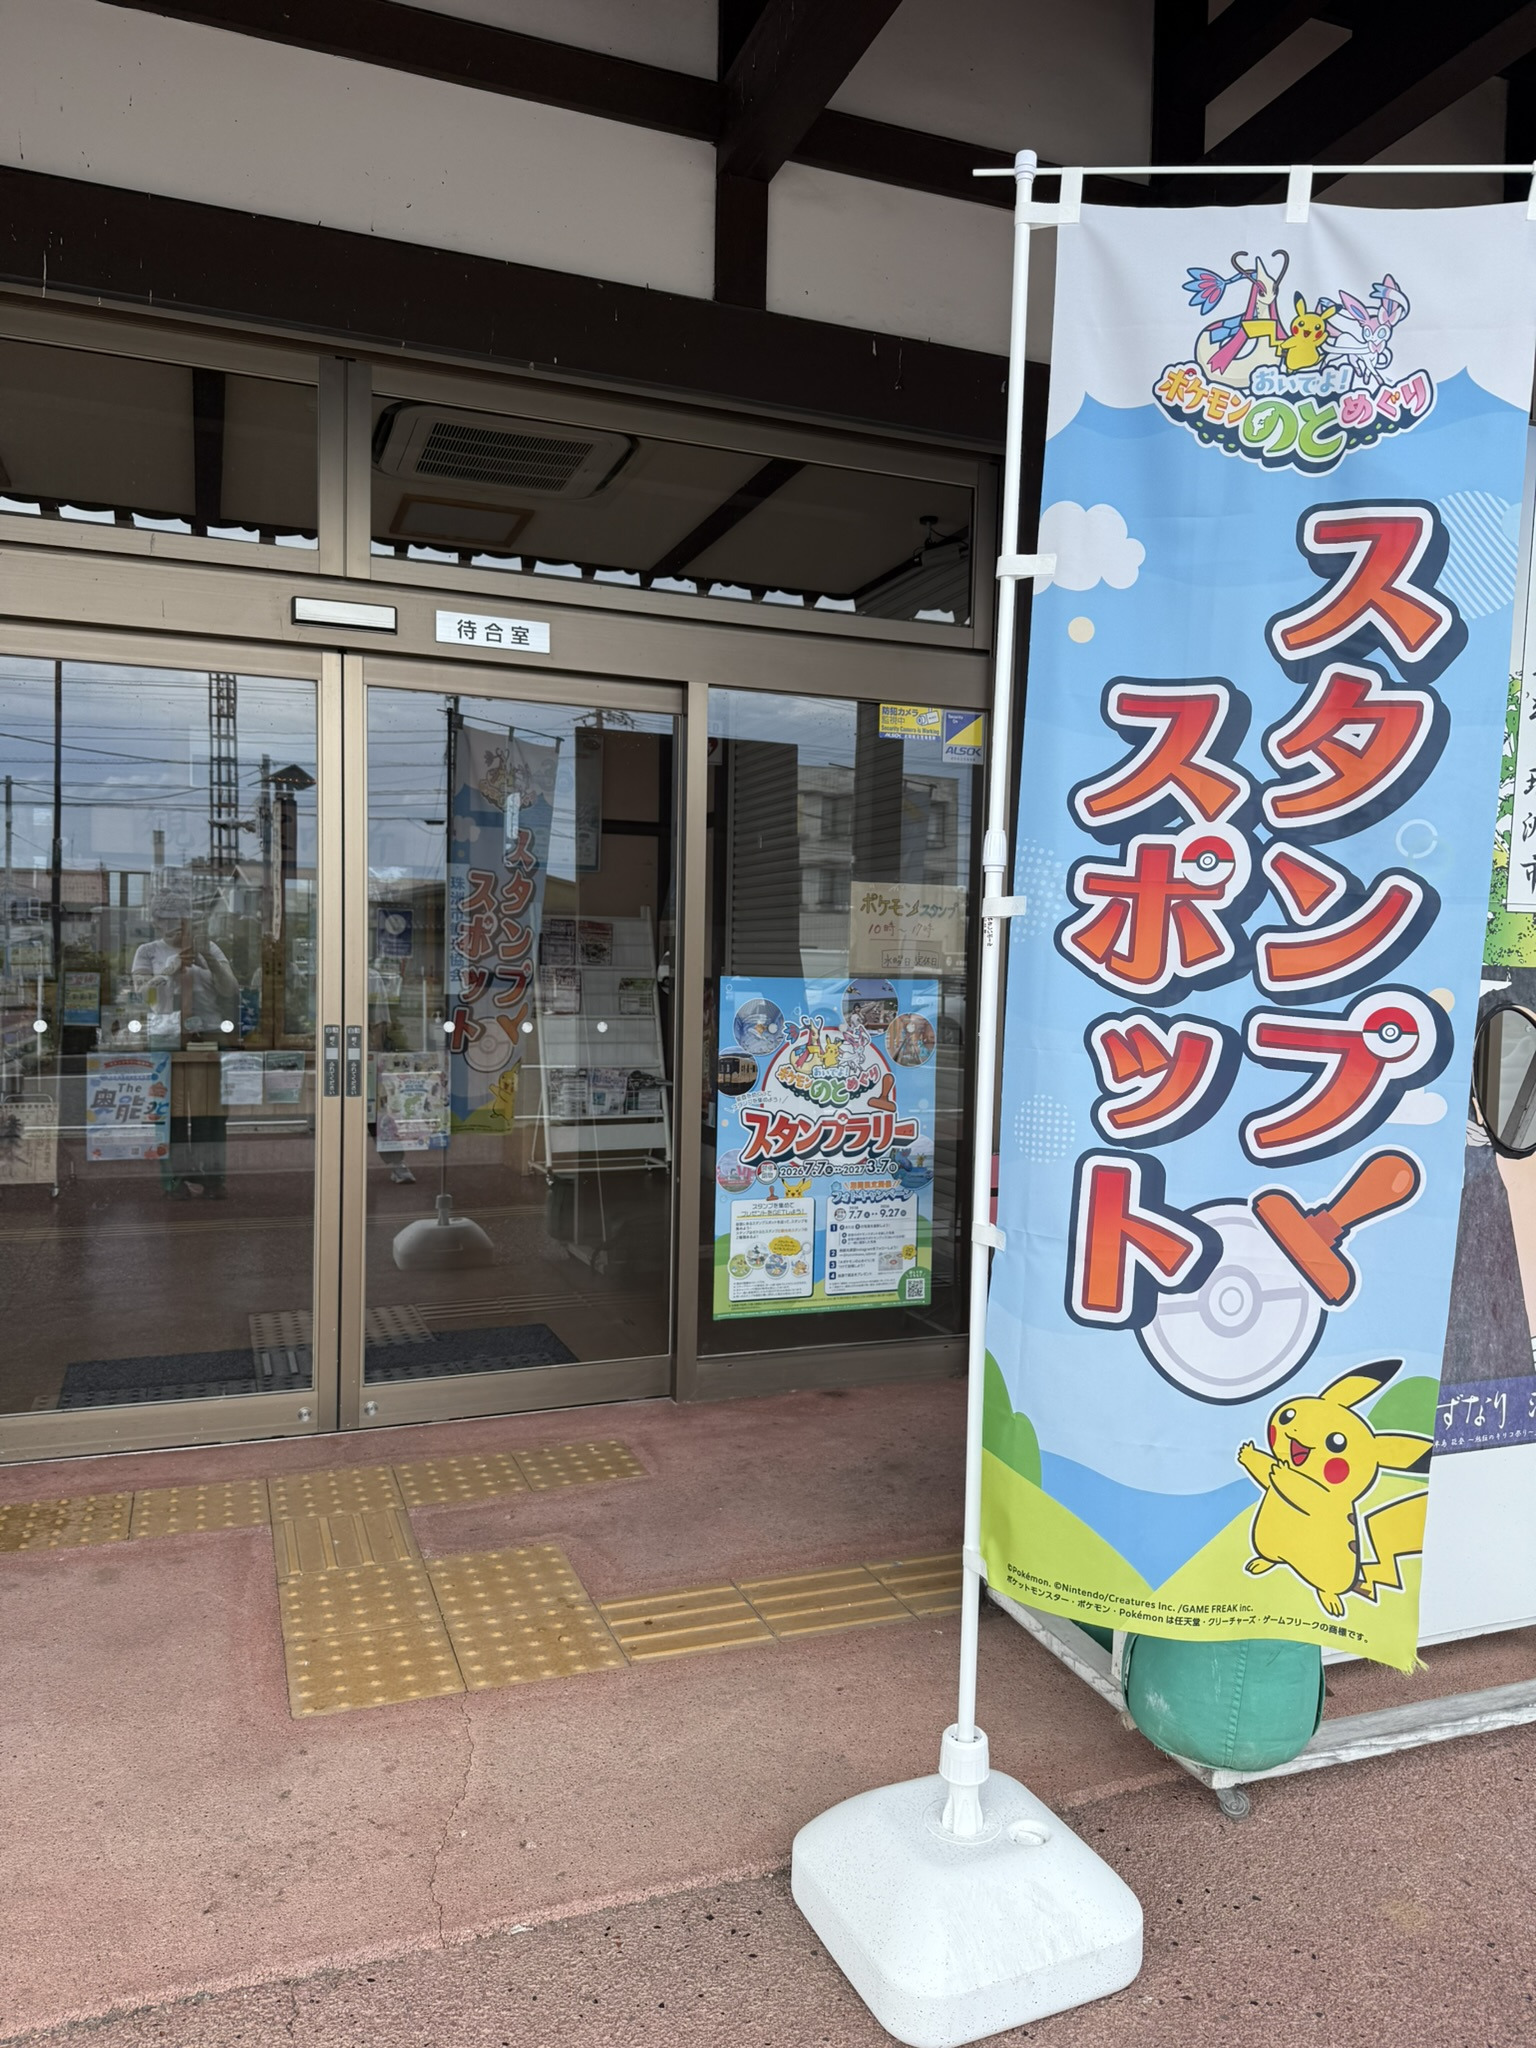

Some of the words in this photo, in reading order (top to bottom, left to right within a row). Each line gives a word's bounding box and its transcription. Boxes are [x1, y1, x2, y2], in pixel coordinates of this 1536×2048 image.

[1254, 368, 1349, 392] おいでよ!
[1158, 369, 1251, 424] ポケモン
[1340, 375, 1427, 425] めぐり
[1242, 400, 1344, 459] のと
[456, 618, 530, 646] 待合室
[881, 706, 919, 717] 防犯カメラ
[945, 746, 982, 757] ALSOK
[1248, 510, 1450, 1156] スタンプ
[1066, 687, 1248, 1315] スポット
[118, 1083, 142, 1093] The
[777, 1066, 813, 1089] ポケモン
[846, 1066, 879, 1090] めぐり
[810, 1080, 849, 1102] のと
[744, 1111, 916, 1160] スタンプラリー
[780, 1168, 803, 1176] 2026
[1006, 1563, 1052, 1588] ©Pokémon.
[1053, 1581, 1156, 1610] ©Nintendo/Creatures
[1157, 1601, 1176, 1613] Inc.
[1177, 1604, 1210, 1614] /GAME
[1211, 1603, 1239, 1614] FREAK
[1239, 1603, 1254, 1612] inc.
